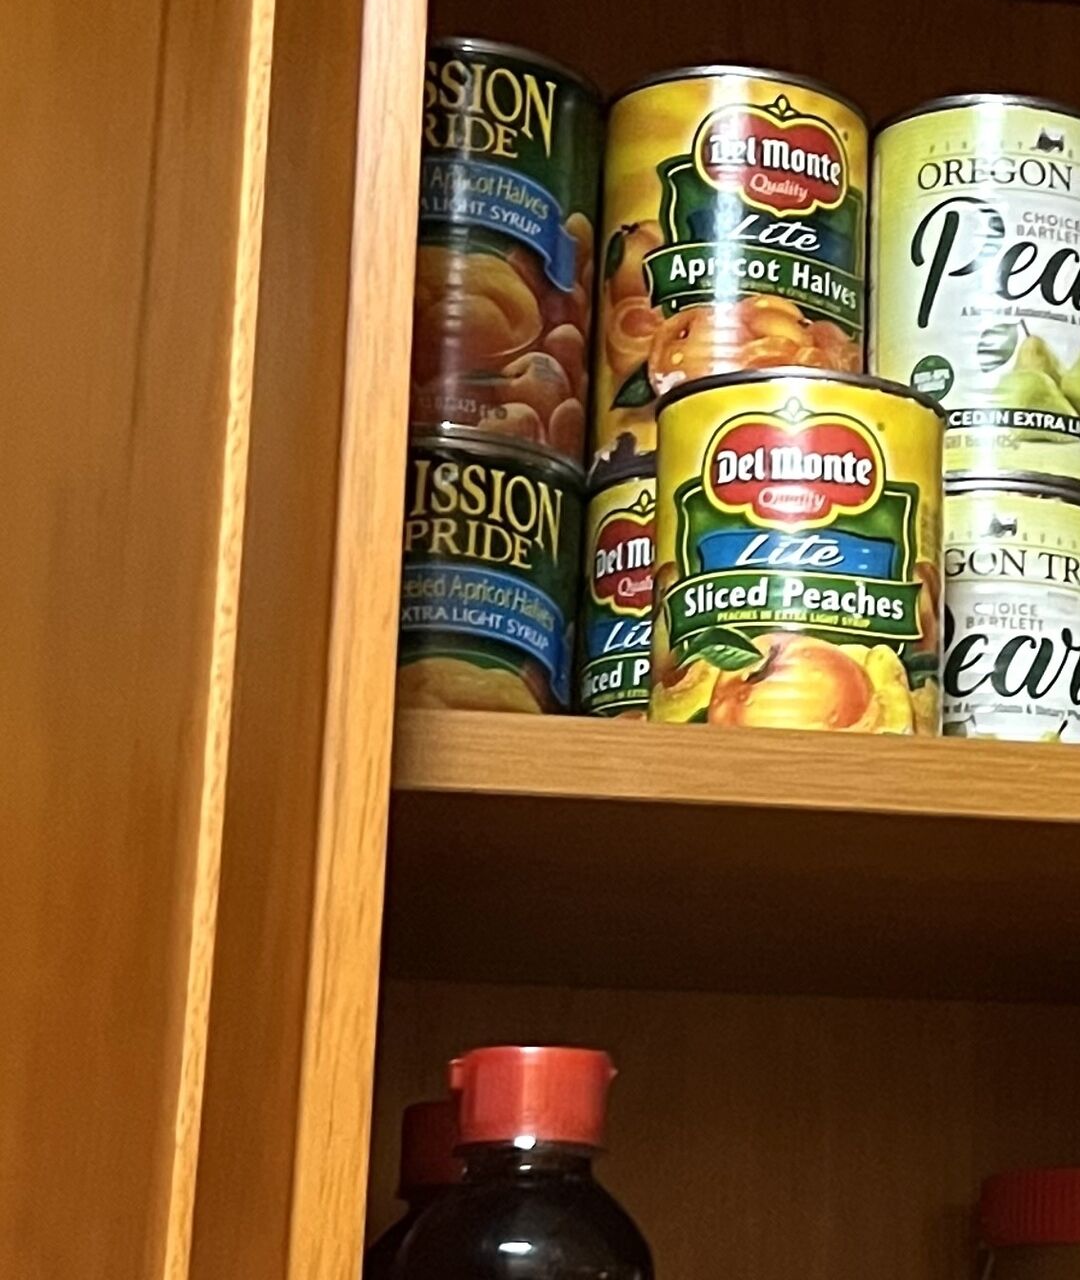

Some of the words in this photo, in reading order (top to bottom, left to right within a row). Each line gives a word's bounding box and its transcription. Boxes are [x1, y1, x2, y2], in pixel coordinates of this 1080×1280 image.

[709, 134, 756, 166] Del
[761, 138, 841, 186] Monte
[917, 158, 1072, 192] OREGON
[750, 173, 808, 203] Quality
[726, 214, 820, 251] Lite
[1022, 211, 1080, 232] CHOICE
[669, 254, 781, 285] Aprcot
[791, 262, 857, 309] Halves
[1013, 411, 1066, 433] EXTRA
[717, 447, 765, 485] Del
[770, 446, 873, 487] Monte
[734, 534, 845, 567] Lite
[684, 577, 768, 619] Sliced
[782, 577, 904, 621] Peaches
[452, 607, 504, 631] LIGHT
